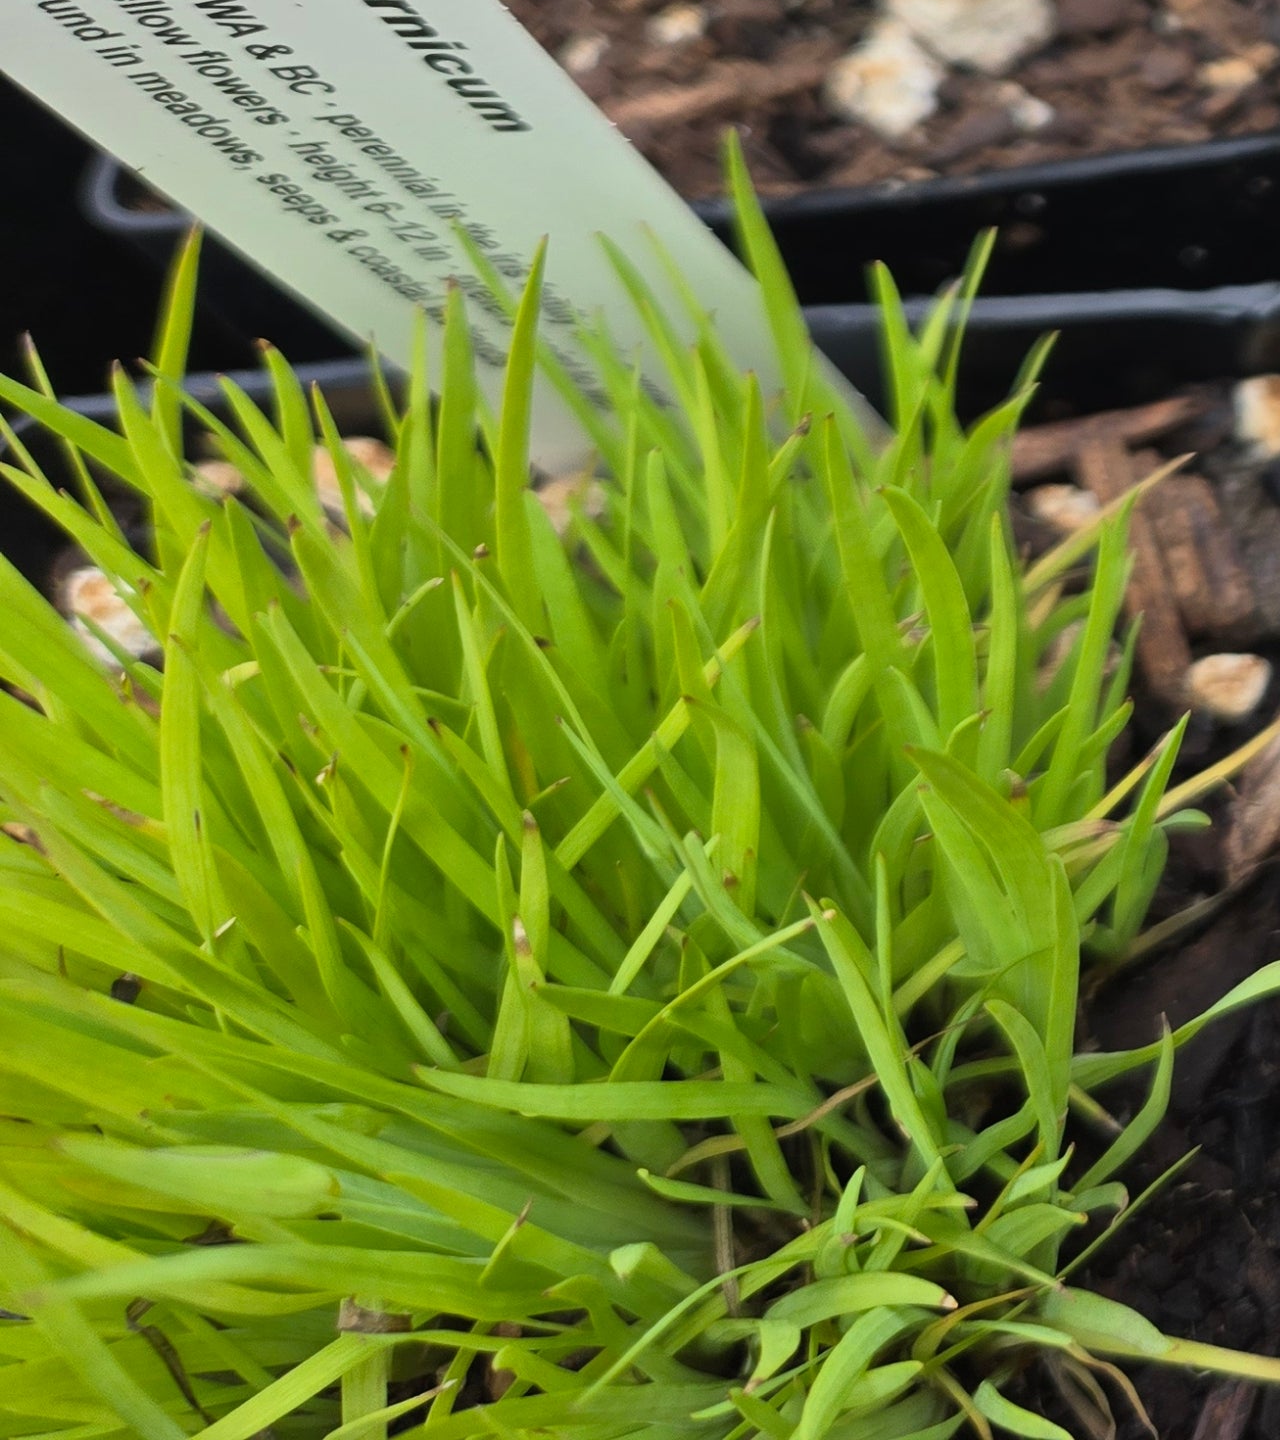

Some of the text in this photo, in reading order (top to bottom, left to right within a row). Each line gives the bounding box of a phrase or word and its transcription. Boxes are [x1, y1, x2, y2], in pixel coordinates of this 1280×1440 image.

[94, 44, 144, 68] in
[126, 71, 263, 171] meadows,
[255, 173, 340, 226] seeps
[179, 50, 290, 126] flowers
[287, 141, 385, 201] height
[412, 246, 452, 262] in
[267, 65, 336, 96] BC
[312, 113, 454, 200] perennial
[427, 203, 470, 222] in
